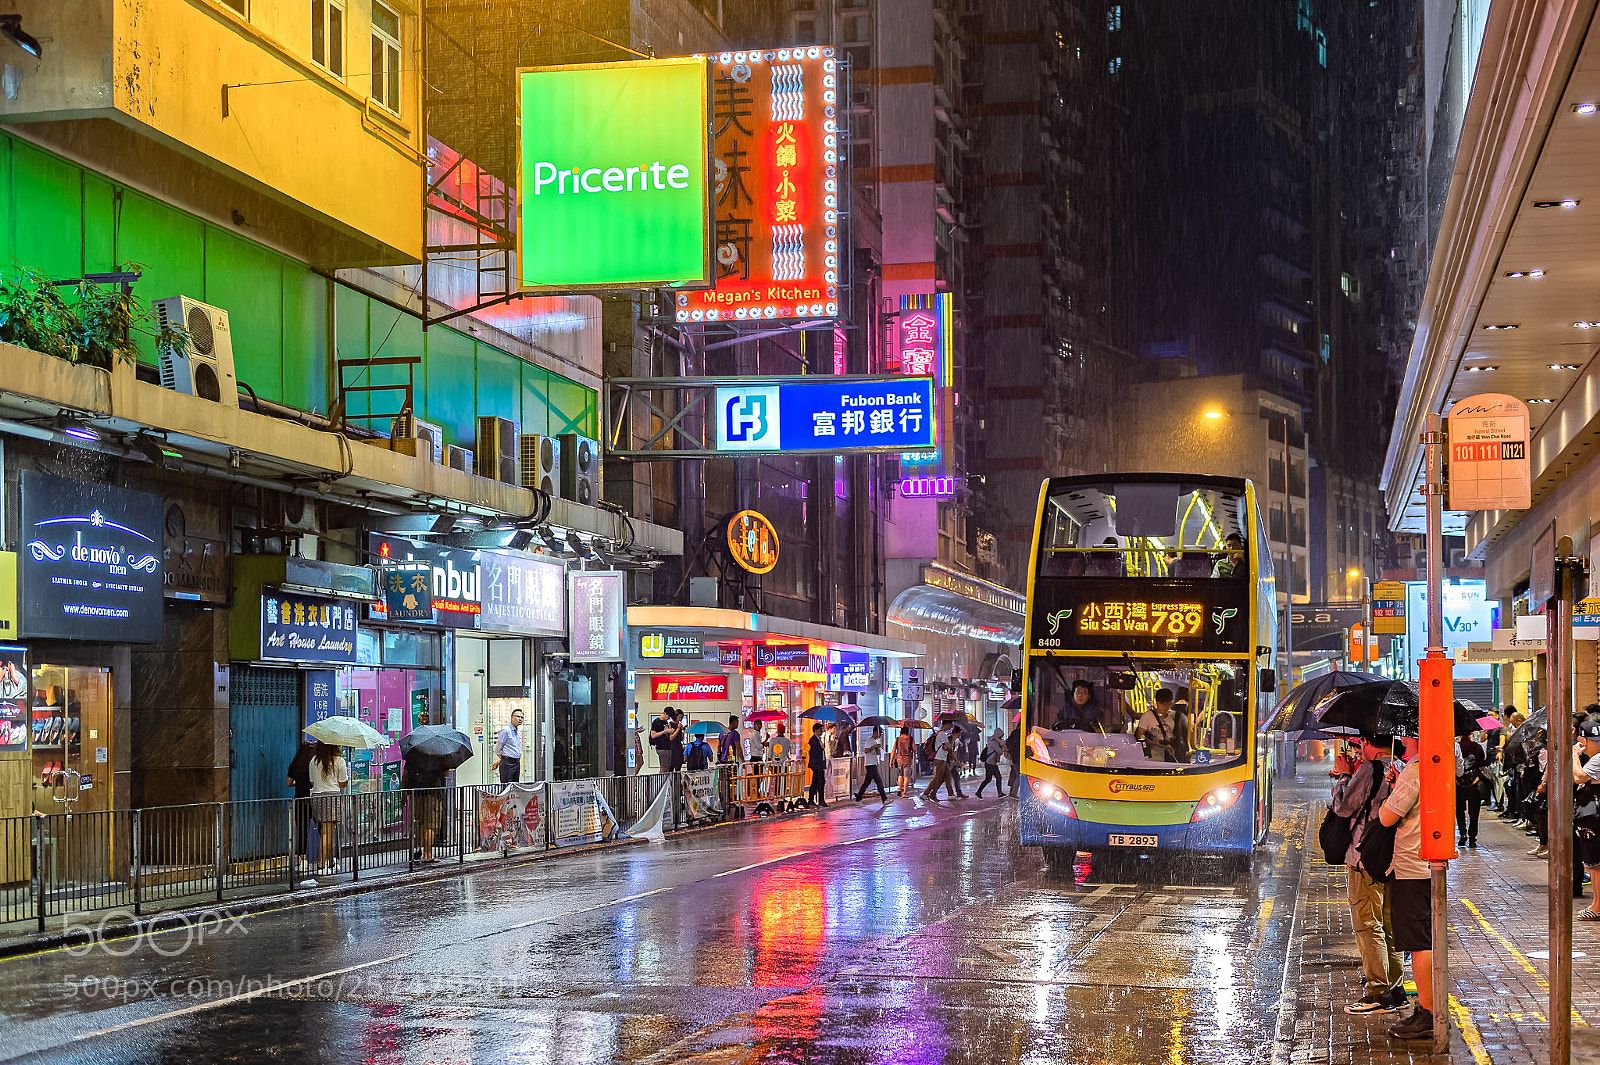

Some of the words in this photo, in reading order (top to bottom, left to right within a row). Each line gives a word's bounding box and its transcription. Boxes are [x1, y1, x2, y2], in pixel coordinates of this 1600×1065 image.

[534, 160, 690, 196] Pricerite
[703, 288, 762, 305] Megan's
[767, 285, 821, 301] Kitchen
[841, 394, 885, 407] Fubon
[886, 392, 922, 406] Bank
[812, 407, 923, 437] 富邦銀行
[1455, 445, 1474, 460] 101
[1480, 444, 1498, 459] 111
[1502, 443, 1523, 458] N121
[71, 530, 88, 562] de
[90, 545, 120, 565] novo
[109, 564, 127, 576] men
[389, 573, 428, 594] 洗衣
[63, 603, 129, 619] www.denovomen.com
[389, 610, 430, 618] LAUNDRY
[487, 602, 524, 618] MAJESTIC
[526, 607, 558, 621] OPTICAL
[589, 578, 604, 650] 名門眼鏡
[1082, 602, 1148, 620] 小西灣
[1151, 602, 1178, 612] Express
[1080, 618, 1099, 632] Siu
[1101, 618, 1121, 632] Sai
[1123, 619, 1149, 632] Wan
[1151, 611, 1201, 634] 789
[266, 630, 286, 648] Art
[288, 631, 316, 649] House
[317, 634, 353, 655] Laundry
[674, 636, 699, 645] HOTEL
[1038, 638, 1061, 647] 8400
[656, 683, 679, 694] 惠康
[679, 682, 725, 693] wellcome
[80, 776, 92, 784] OPEN
[1111, 835, 1125, 844] TB
[1129, 836, 1156, 846] 2893
